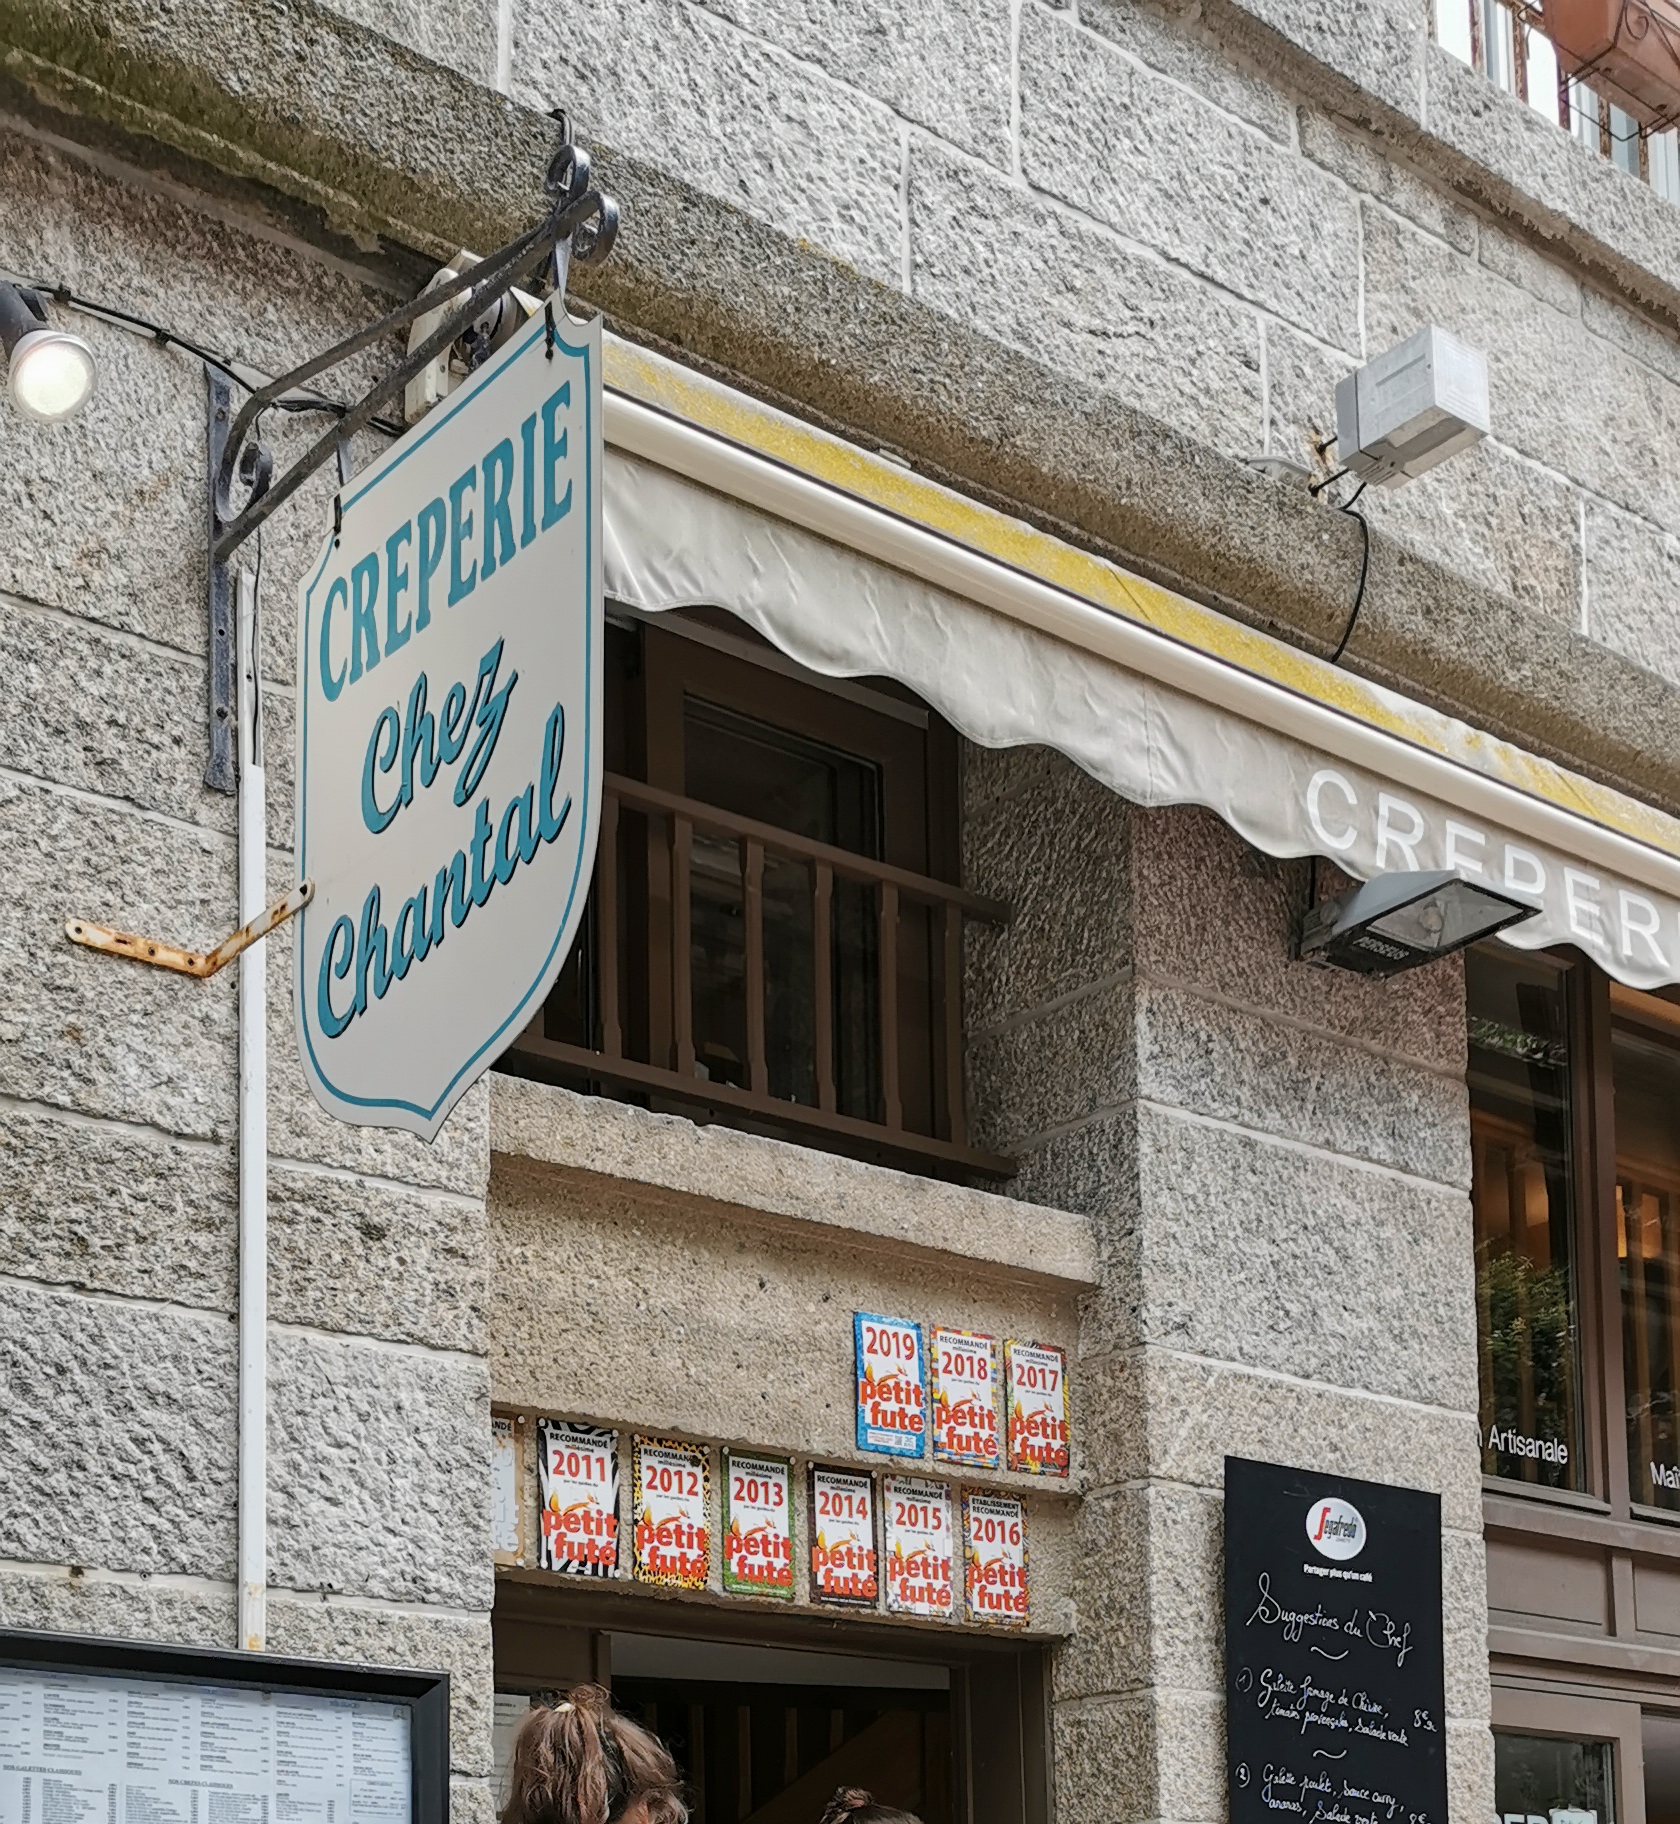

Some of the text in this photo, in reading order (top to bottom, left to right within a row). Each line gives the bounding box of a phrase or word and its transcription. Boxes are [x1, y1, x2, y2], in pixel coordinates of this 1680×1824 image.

[319, 380, 572, 702] CREPERIE
[361, 637, 518, 836] Chez
[317, 702, 572, 1040] Chantal
[1306, 769, 1680, 967] CREPER
[865, 1326, 915, 1361] 2019
[940, 1335, 988, 1350] RECOMMANDÉ
[1013, 1348, 1059, 1363] RECOMMANDÉ
[941, 1351, 988, 1380] 2018
[1016, 1363, 1059, 1392] 2017
[860, 1380, 923, 1407] petit
[935, 1402, 997, 1432] petit
[1009, 1416, 1069, 1442] petit
[550, 1432, 608, 1449] RECOMMANDÉ
[643, 1448, 690, 1462] RECOMMAN
[946, 1426, 998, 1456] futé
[1020, 1436, 1068, 1467] futé
[1488, 1424, 1568, 1464] Artisanale
[552, 1449, 606, 1482] 2011
[731, 1459, 785, 1475] RECOMMANDÉ
[1650, 1461, 1680, 1489] Maî
[646, 1465, 699, 1497] 2012
[733, 1476, 784, 1507] 2013
[817, 1475, 868, 1489] RECOMMANDÉ
[893, 1486, 943, 1500] RECOMMANDÉ
[819, 1491, 868, 1521] 2014
[895, 1501, 942, 1531] 2015
[542, 1508, 619, 1538] petit
[636, 1523, 708, 1552] petit
[972, 1516, 1021, 1546] 2016
[554, 1531, 617, 1565] futé
[647, 1545, 708, 1577] futé
[724, 1533, 793, 1562] petit
[811, 1545, 877, 1573] petit
[736, 1555, 793, 1586] futé
[822, 1567, 878, 1598] futé
[888, 1555, 951, 1581] petit
[967, 1563, 1027, 1589] petit
[899, 1578, 951, 1607] futé
[977, 1584, 1027, 1613] futé
[1245, 1571, 1413, 1667] Suggestions du Chef
[1337, 1688, 1349, 1706] de
